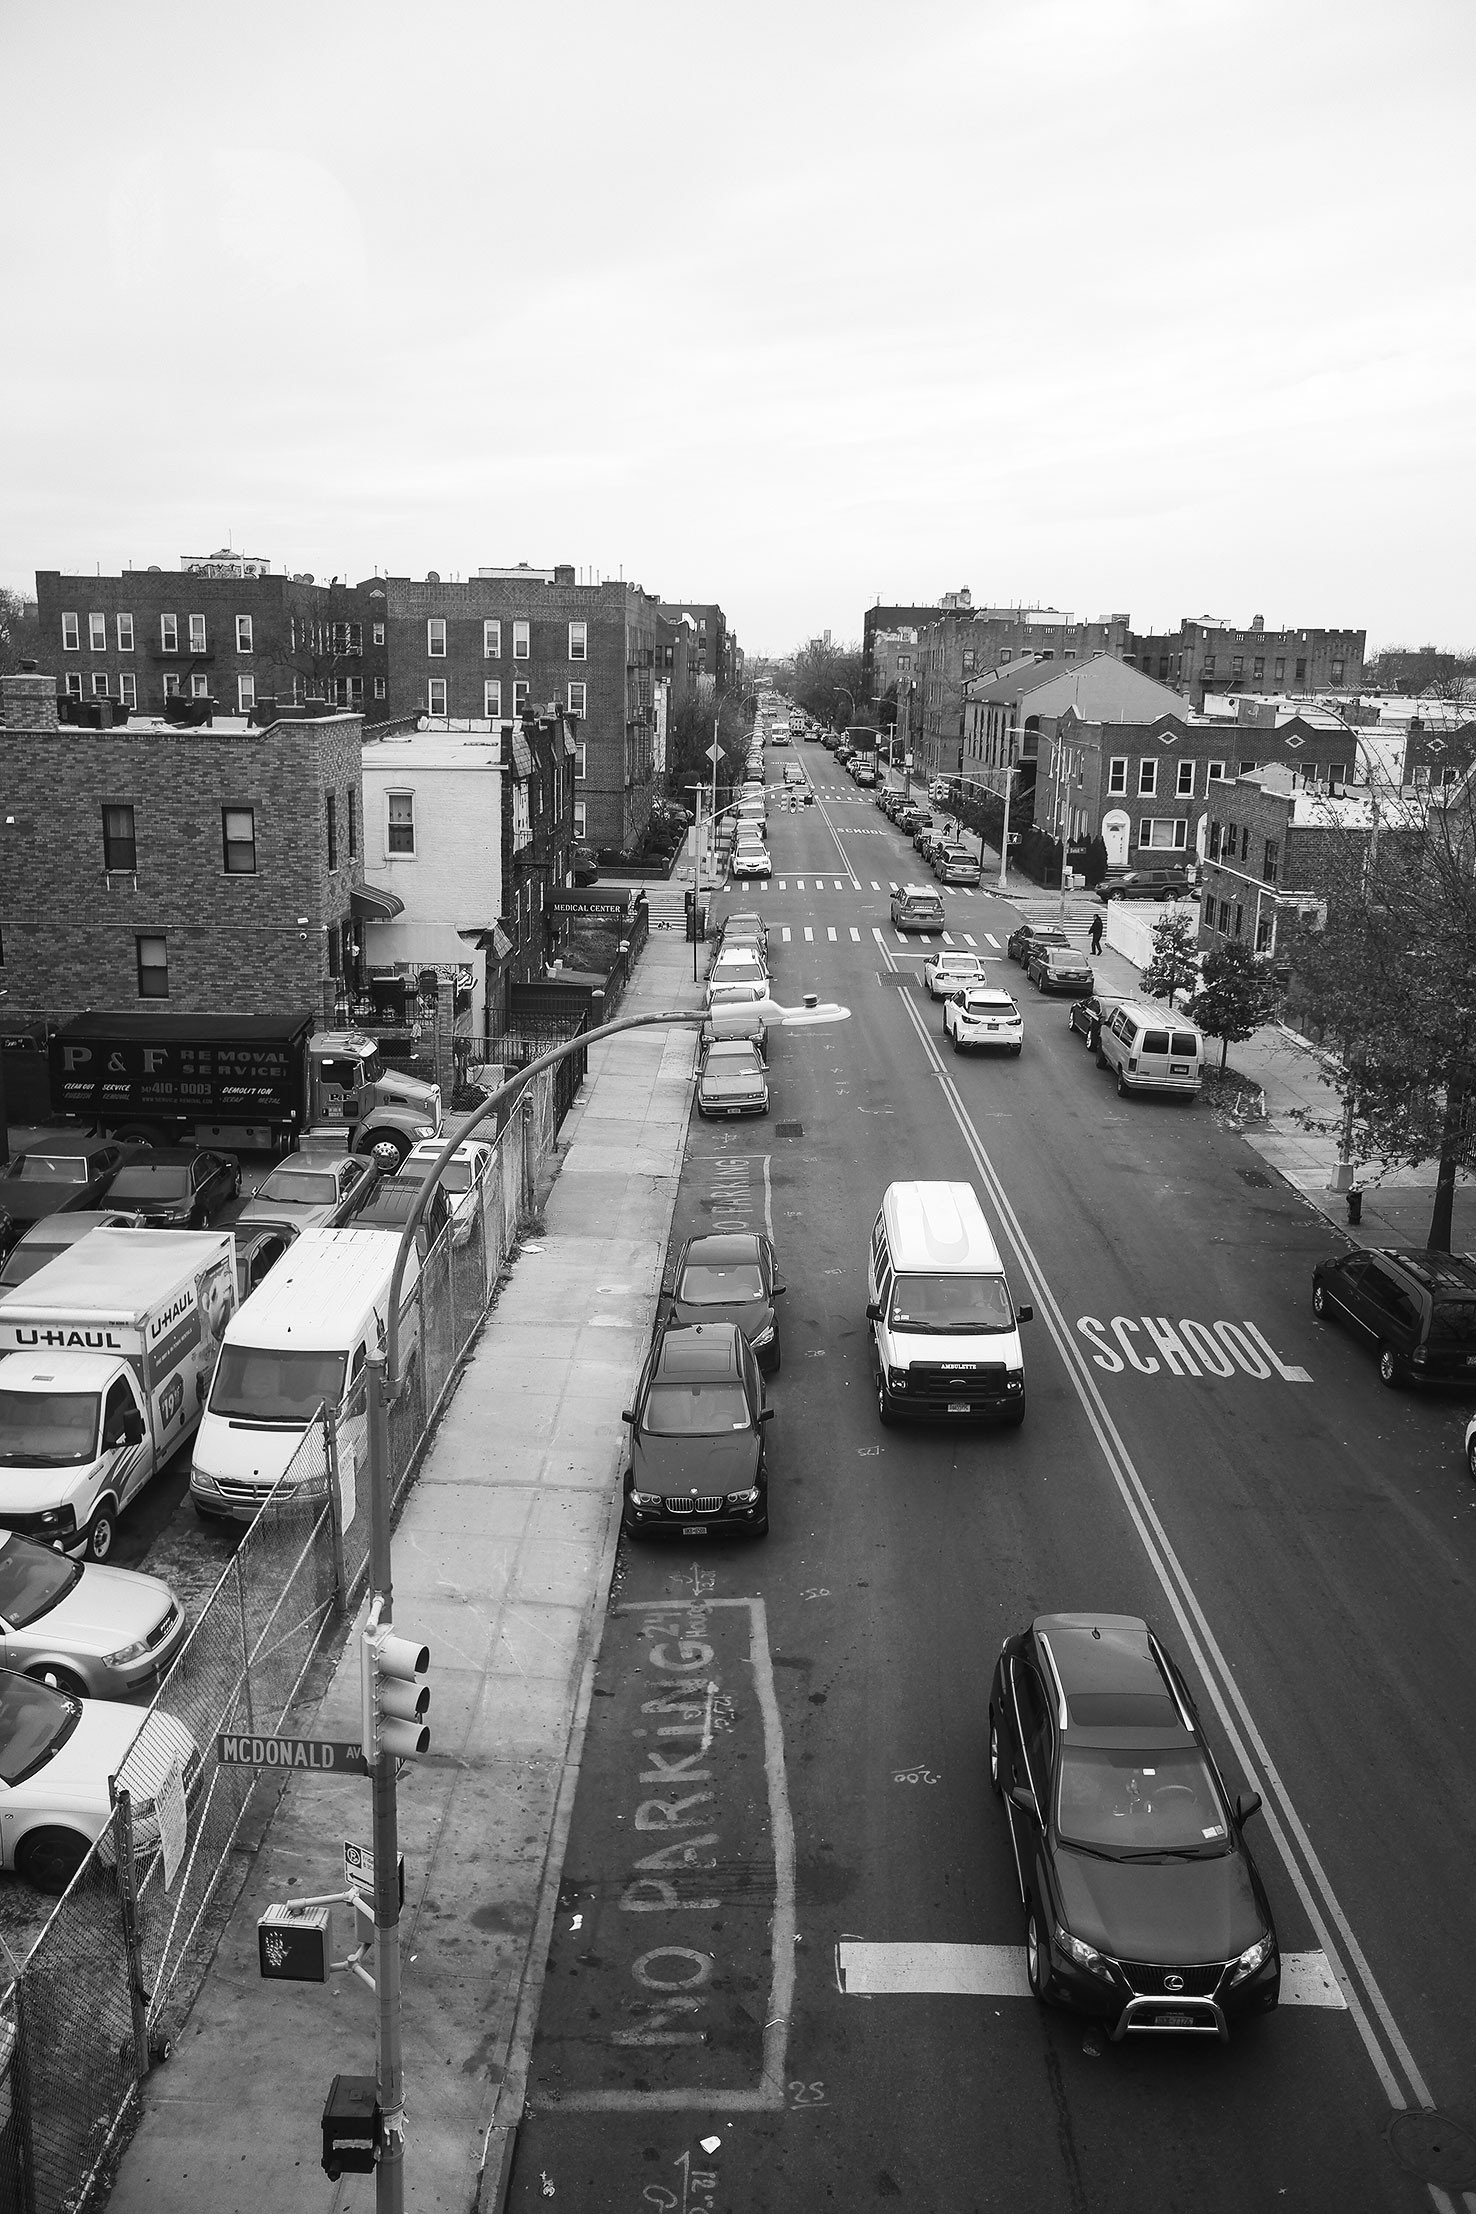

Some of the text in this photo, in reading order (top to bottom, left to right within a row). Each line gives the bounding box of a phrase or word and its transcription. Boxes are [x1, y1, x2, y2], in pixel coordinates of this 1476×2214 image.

[554, 904, 621, 913] MEDICAL CENTER
[63, 1046, 169, 1073] P & F
[180, 1050, 289, 1063] REMOVAL
[101, 1083, 132, 1092] SERVICE
[710, 1159, 753, 1213] PARKING
[151, 1291, 193, 1339] U-HAUL
[15, 1328, 121, 1349] U-HAUL
[1076, 1315, 1314, 1382] SCHOOL
[223, 1737, 361, 1768] MCDONALD AV
[611, 1945, 714, 2046] NO
